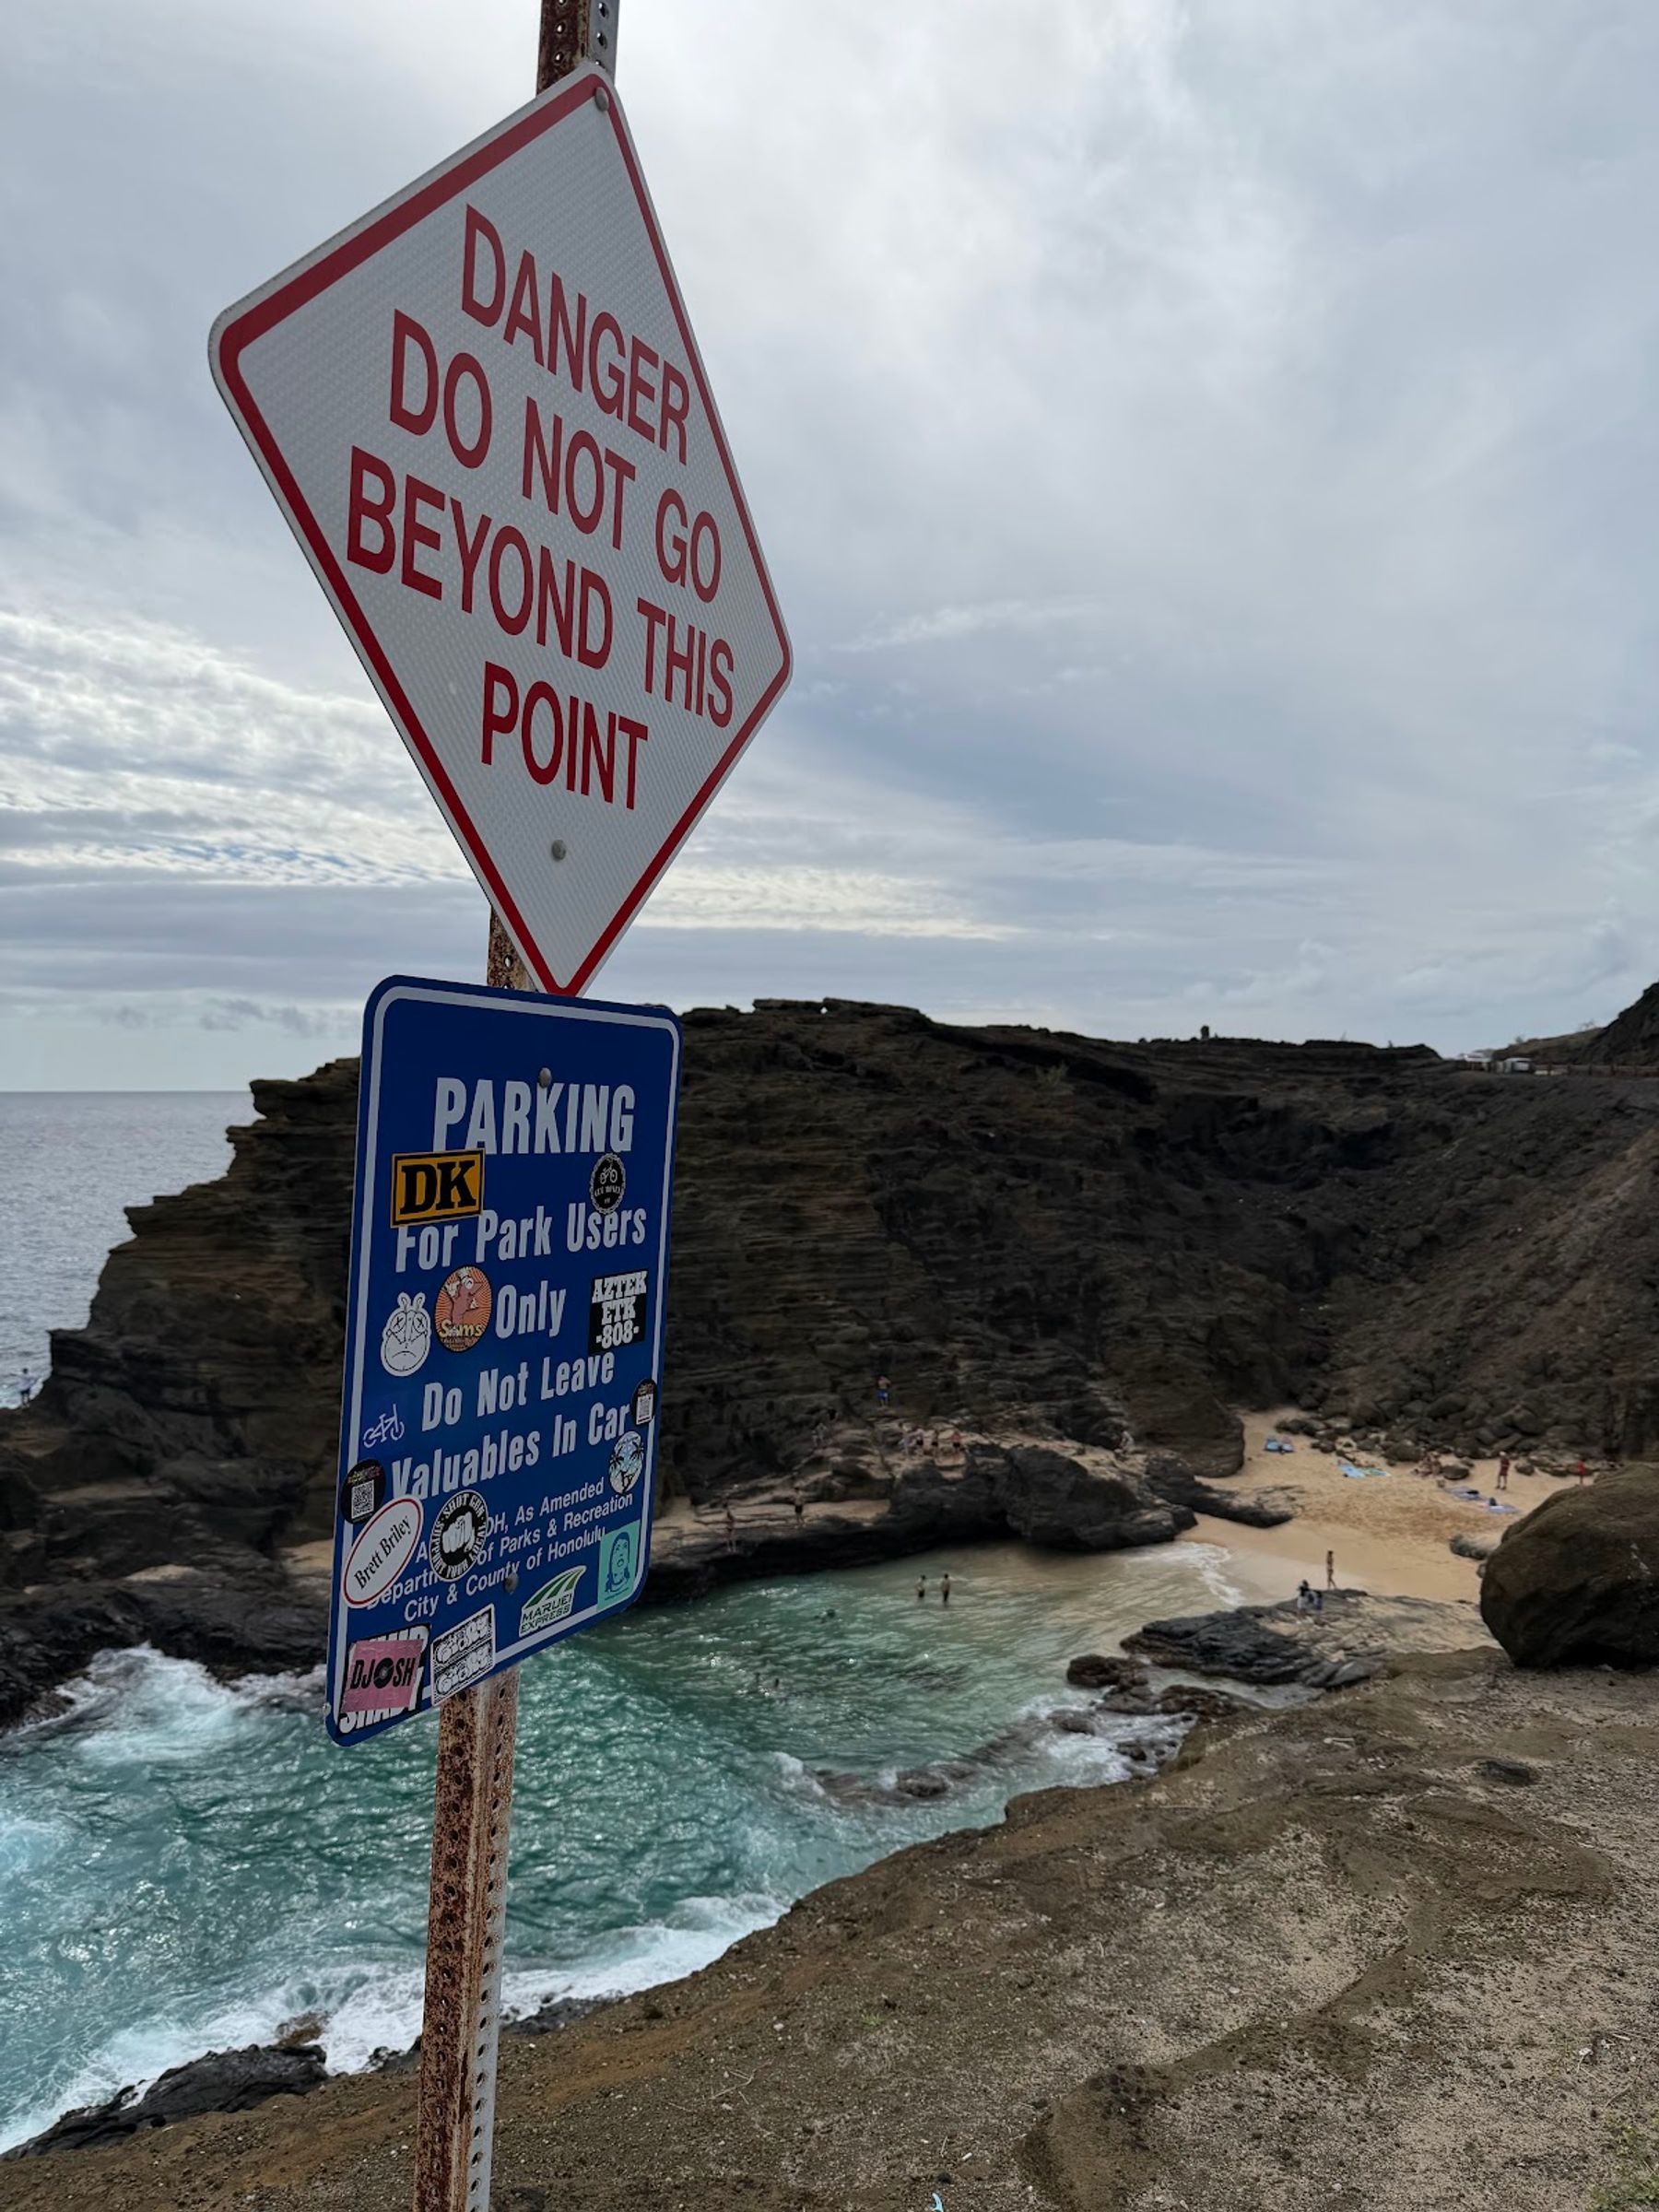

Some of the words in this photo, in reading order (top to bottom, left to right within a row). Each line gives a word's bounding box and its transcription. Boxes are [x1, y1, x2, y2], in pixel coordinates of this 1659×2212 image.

[462, 203, 689, 465] DANGER
[390, 308, 492, 468] DO
[523, 398, 636, 552] NOT
[656, 488, 721, 604] GO
[347, 444, 613, 669] BEYOND
[637, 598, 734, 729] THIS
[481, 660, 649, 811] POINT
[433, 1077, 635, 1155] PARKING
[400, 1160, 475, 1216] DK
[395, 1223, 459, 1273] For
[476, 1206, 552, 1263] Park
[567, 1203, 646, 1253] Users
[496, 1280, 567, 1338] Only
[592, 1271, 648, 1303] AZTEK
[601, 1296, 637, 1325] ETK
[421, 1382, 462, 1432] Do
[477, 1361, 529, 1417] Not
[541, 1352, 615, 1400] Leave
[392, 1431, 540, 1500] Valuables
[553, 1406, 577, 1458] In
[588, 1402, 630, 1447] Car
[477, 1545, 494, 1566] of
[500, 1530, 541, 1557] Parks
[547, 1519, 557, 1536] &
[564, 1493, 633, 1531] Recreation
[514, 1505, 535, 1526] As
[539, 1477, 605, 1516] Amended
[354, 1549, 383, 1589] Brett
[379, 1515, 412, 1558] Briley
[405, 1594, 439, 1622] City
[446, 1583, 458, 1605] &
[465, 1560, 520, 1596] County
[526, 1549, 544, 1570] of
[547, 1526, 606, 1561] Honolulu
[520, 1604, 571, 1633] EXPRESS
[523, 1594, 572, 1621] MARUEI
